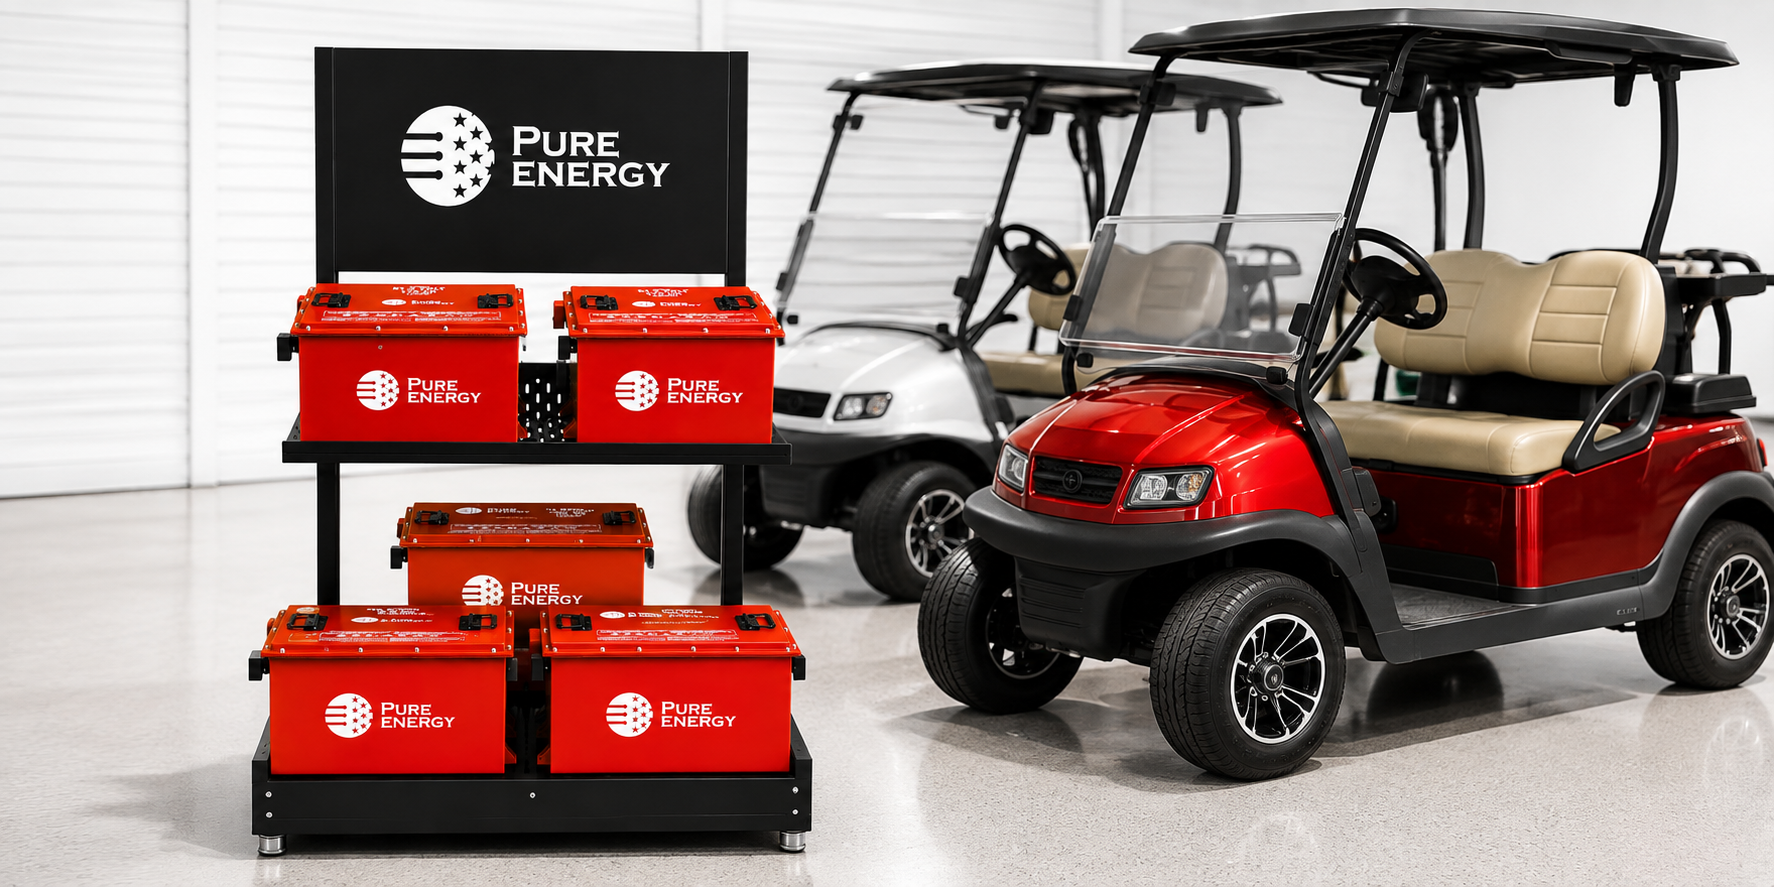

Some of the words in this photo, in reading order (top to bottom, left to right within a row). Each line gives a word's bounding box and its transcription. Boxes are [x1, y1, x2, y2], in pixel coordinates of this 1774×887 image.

[512, 125, 620, 158] PURE
[511, 160, 671, 188] ENERGY
[407, 377, 458, 391] PURE
[667, 377, 720, 391] PURE
[407, 391, 482, 403] ENERGY
[667, 391, 744, 404] ENERGY
[511, 582, 560, 594] PURE
[511, 594, 583, 606] ENERGY
[380, 702, 432, 715] PURE
[661, 701, 713, 715] PURE
[380, 716, 455, 728] ENERGY
[661, 715, 737, 727] ENERGY
